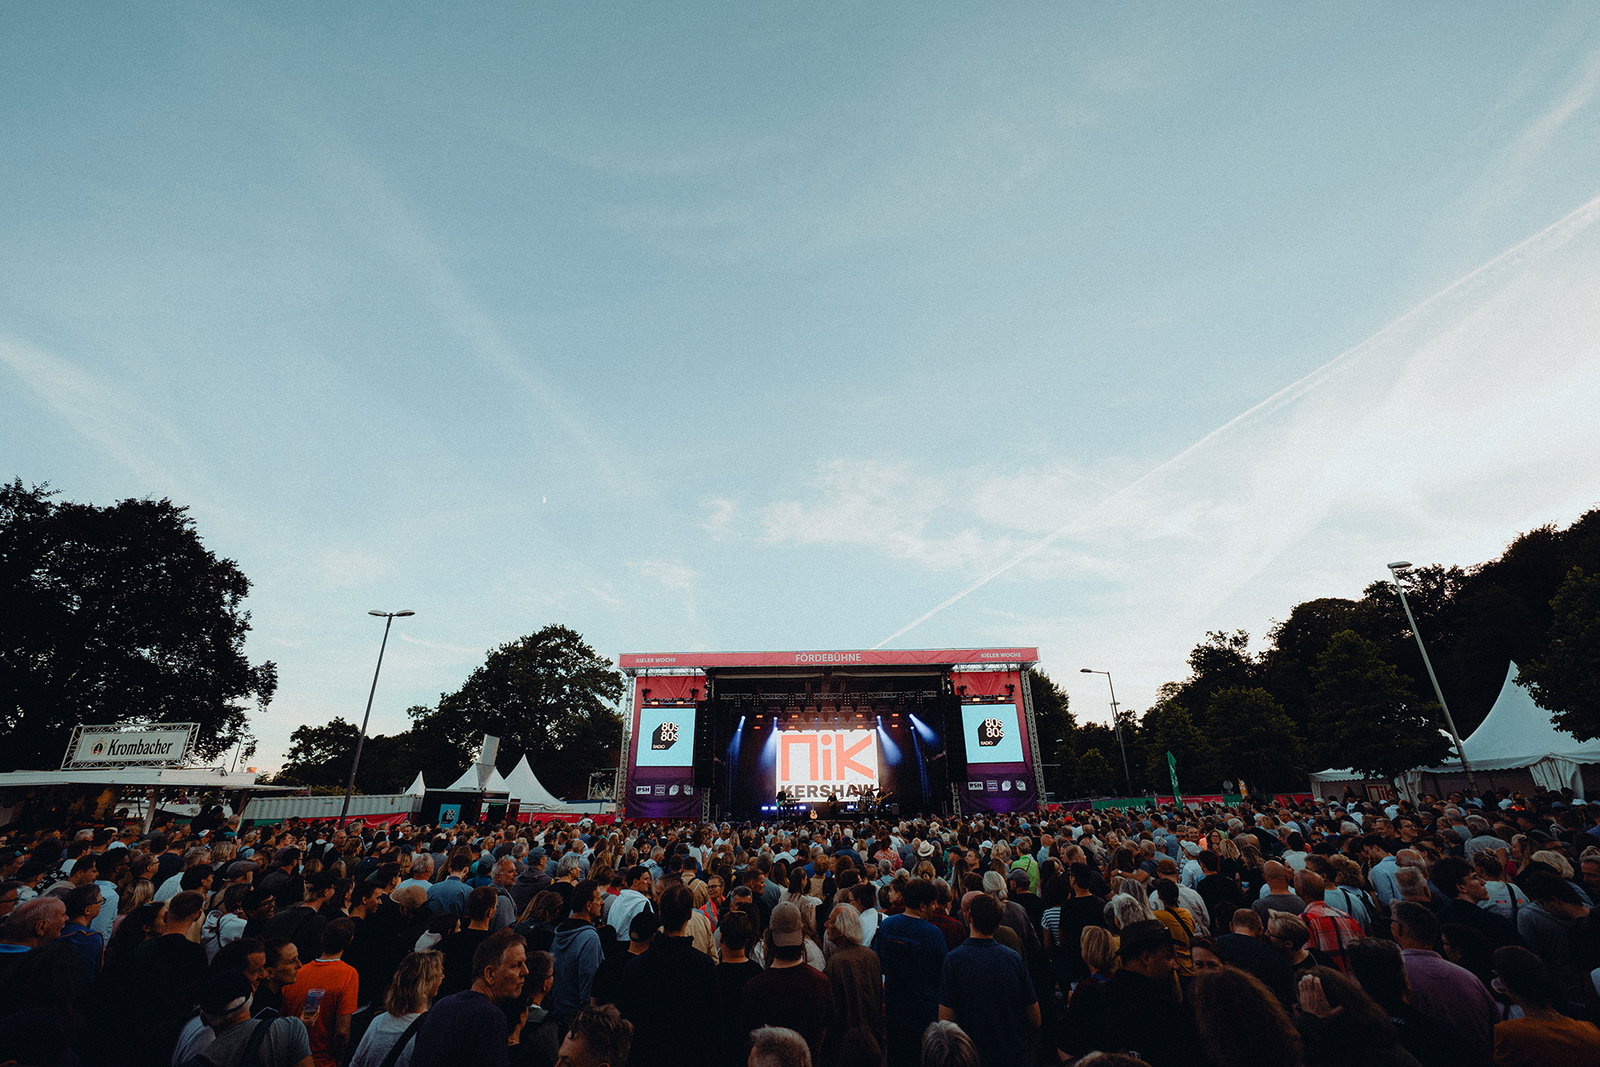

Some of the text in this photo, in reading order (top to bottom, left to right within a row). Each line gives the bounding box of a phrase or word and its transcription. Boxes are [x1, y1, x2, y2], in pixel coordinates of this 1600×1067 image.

[795, 652, 862, 662] FÖRDEBÜHNE
[661, 721, 680, 731] 80s
[985, 717, 1004, 727] 80s
[660, 731, 679, 741] 80s
[986, 727, 1005, 738] 80s
[107, 739, 173, 755] Krombacher
